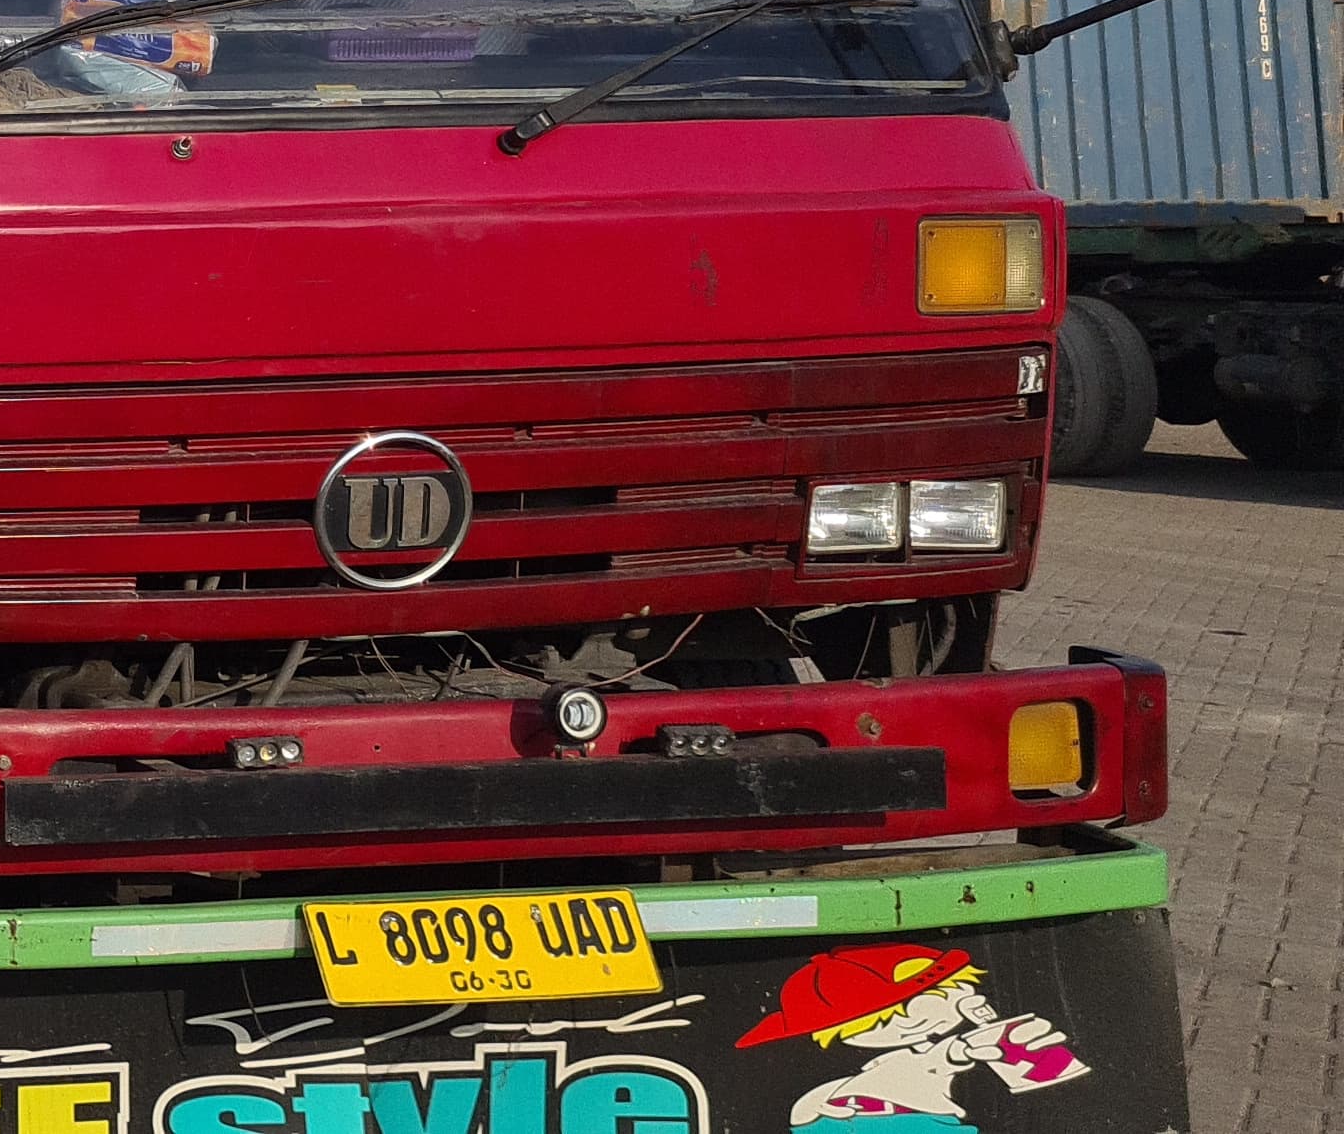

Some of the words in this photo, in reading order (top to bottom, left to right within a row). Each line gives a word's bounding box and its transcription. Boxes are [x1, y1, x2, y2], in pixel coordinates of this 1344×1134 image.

[344, 475, 452, 550] UD
[316, 911, 358, 966] L
[380, 904, 513, 967] 8098
[530, 896, 638, 959] UAD
